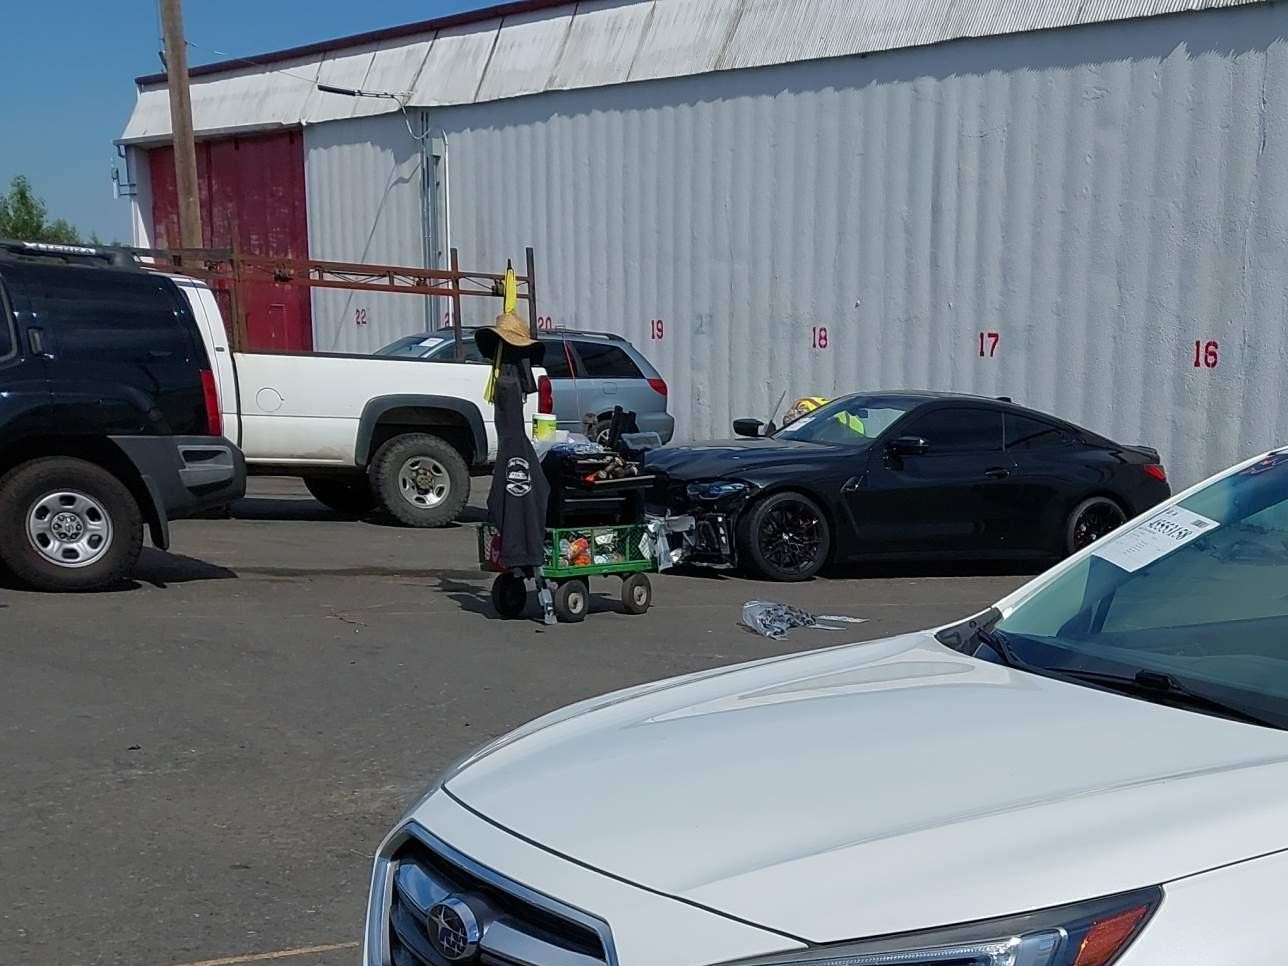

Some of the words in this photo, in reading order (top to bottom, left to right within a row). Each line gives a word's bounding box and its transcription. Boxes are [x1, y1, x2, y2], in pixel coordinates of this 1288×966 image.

[355, 309, 367, 325] 22
[650, 319, 664, 339] 19
[812, 326, 828, 349] 18
[979, 332, 1000, 357] 17
[1194, 340, 1218, 368] 16
